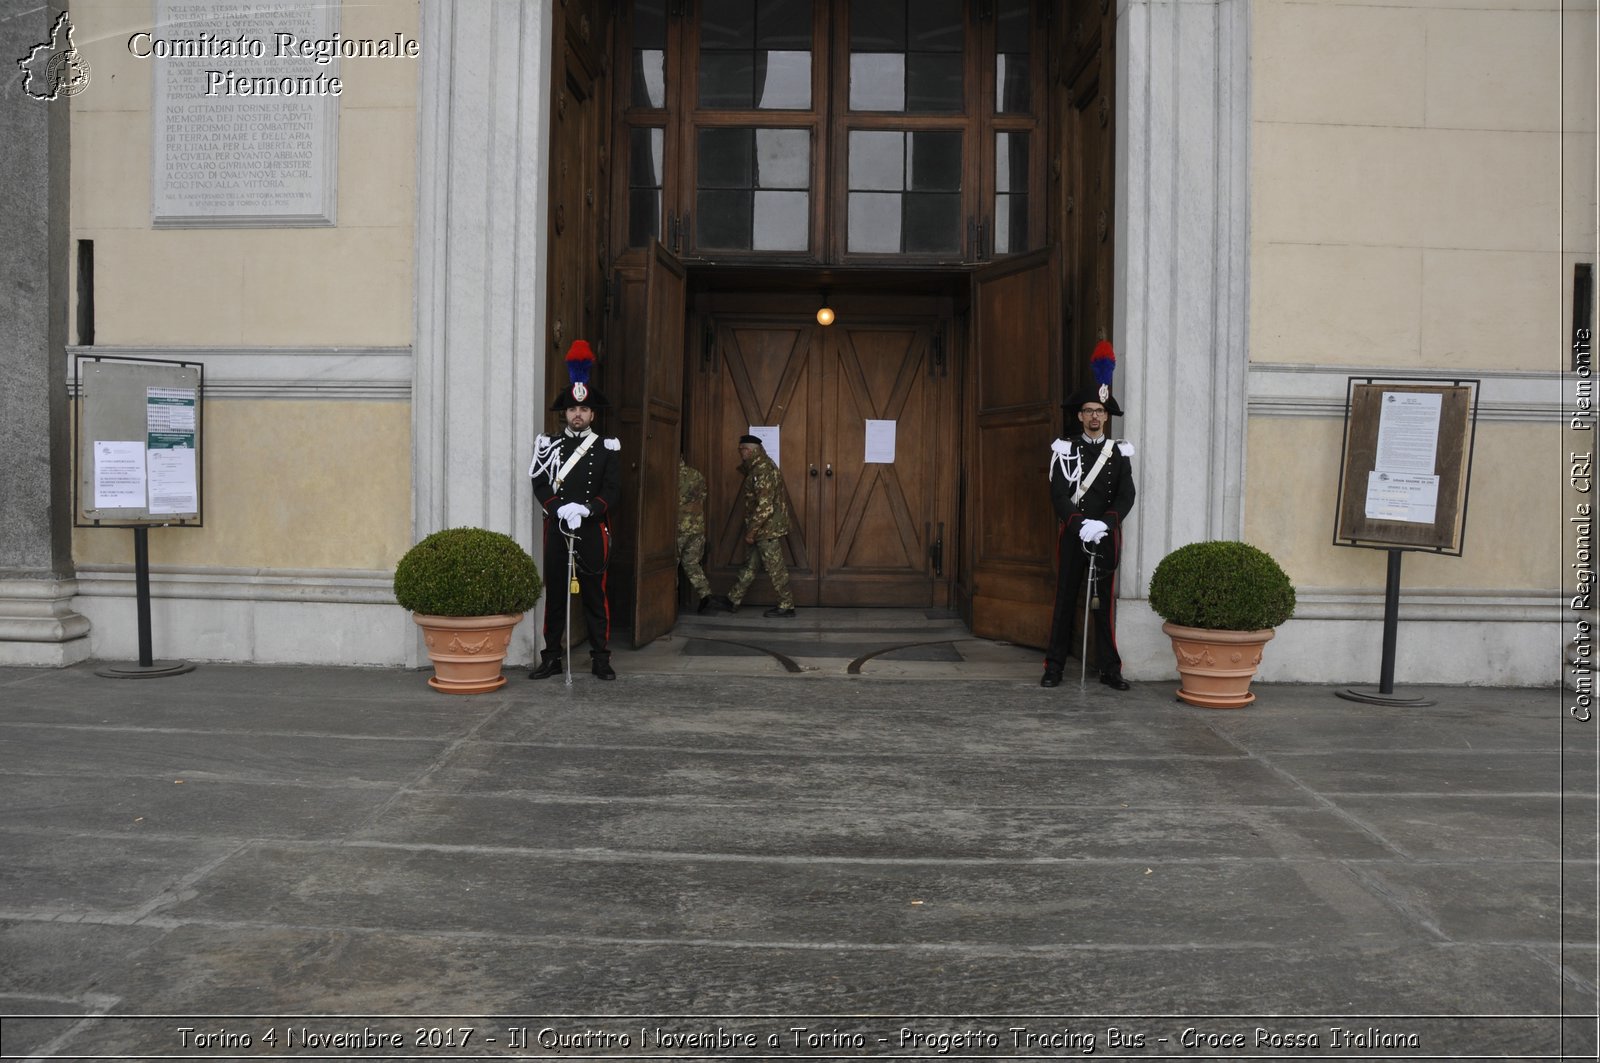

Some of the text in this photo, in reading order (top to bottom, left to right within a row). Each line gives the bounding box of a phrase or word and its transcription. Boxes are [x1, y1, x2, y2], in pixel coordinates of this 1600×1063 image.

[254, 11, 311, 19] EROICAMENTE
[187, 60, 213, 68] DELLA
[216, 59, 260, 67] GAZZETTA
[265, 66, 314, 74] PROCLAMAVA
[166, 103, 313, 114] NOI CITTADINI TORINESI PER LA
[166, 114, 213, 123] MEMORIA
[216, 114, 232, 122] DEI
[236, 113, 270, 122] NOSTRI
[166, 123, 182, 132] PER
[233, 122, 248, 131] DEI
[250, 122, 313, 131] COMBATTENTI
[166, 133, 176, 142] DI
[212, 133, 221, 141] DI
[222, 132, 248, 141] MARE
[252, 132, 258, 140] E
[166, 143, 182, 152] PER
[223, 142, 239, 151] PER
[242, 142, 255, 150] LA
[296, 140, 313, 149] PER
[166, 152, 178, 161] LA
[215, 152, 230, 160] PER
[233, 151, 271, 160] QVANTO
[274, 150, 313, 159] ABBIAMO
[166, 162, 174, 170] DI
[190, 161, 216, 170] CARO
[219, 161, 261, 170] GIVRIAMO
[273, 160, 312, 169] RESISTERE
[167, 171, 173, 179] A
[174, 171, 204, 179] COSTO
[208, 171, 217, 179] DI
[191, 181, 213, 189] FINO
[215, 180, 240, 189] ALLA
[242, 179, 285, 188] VITTORIA
